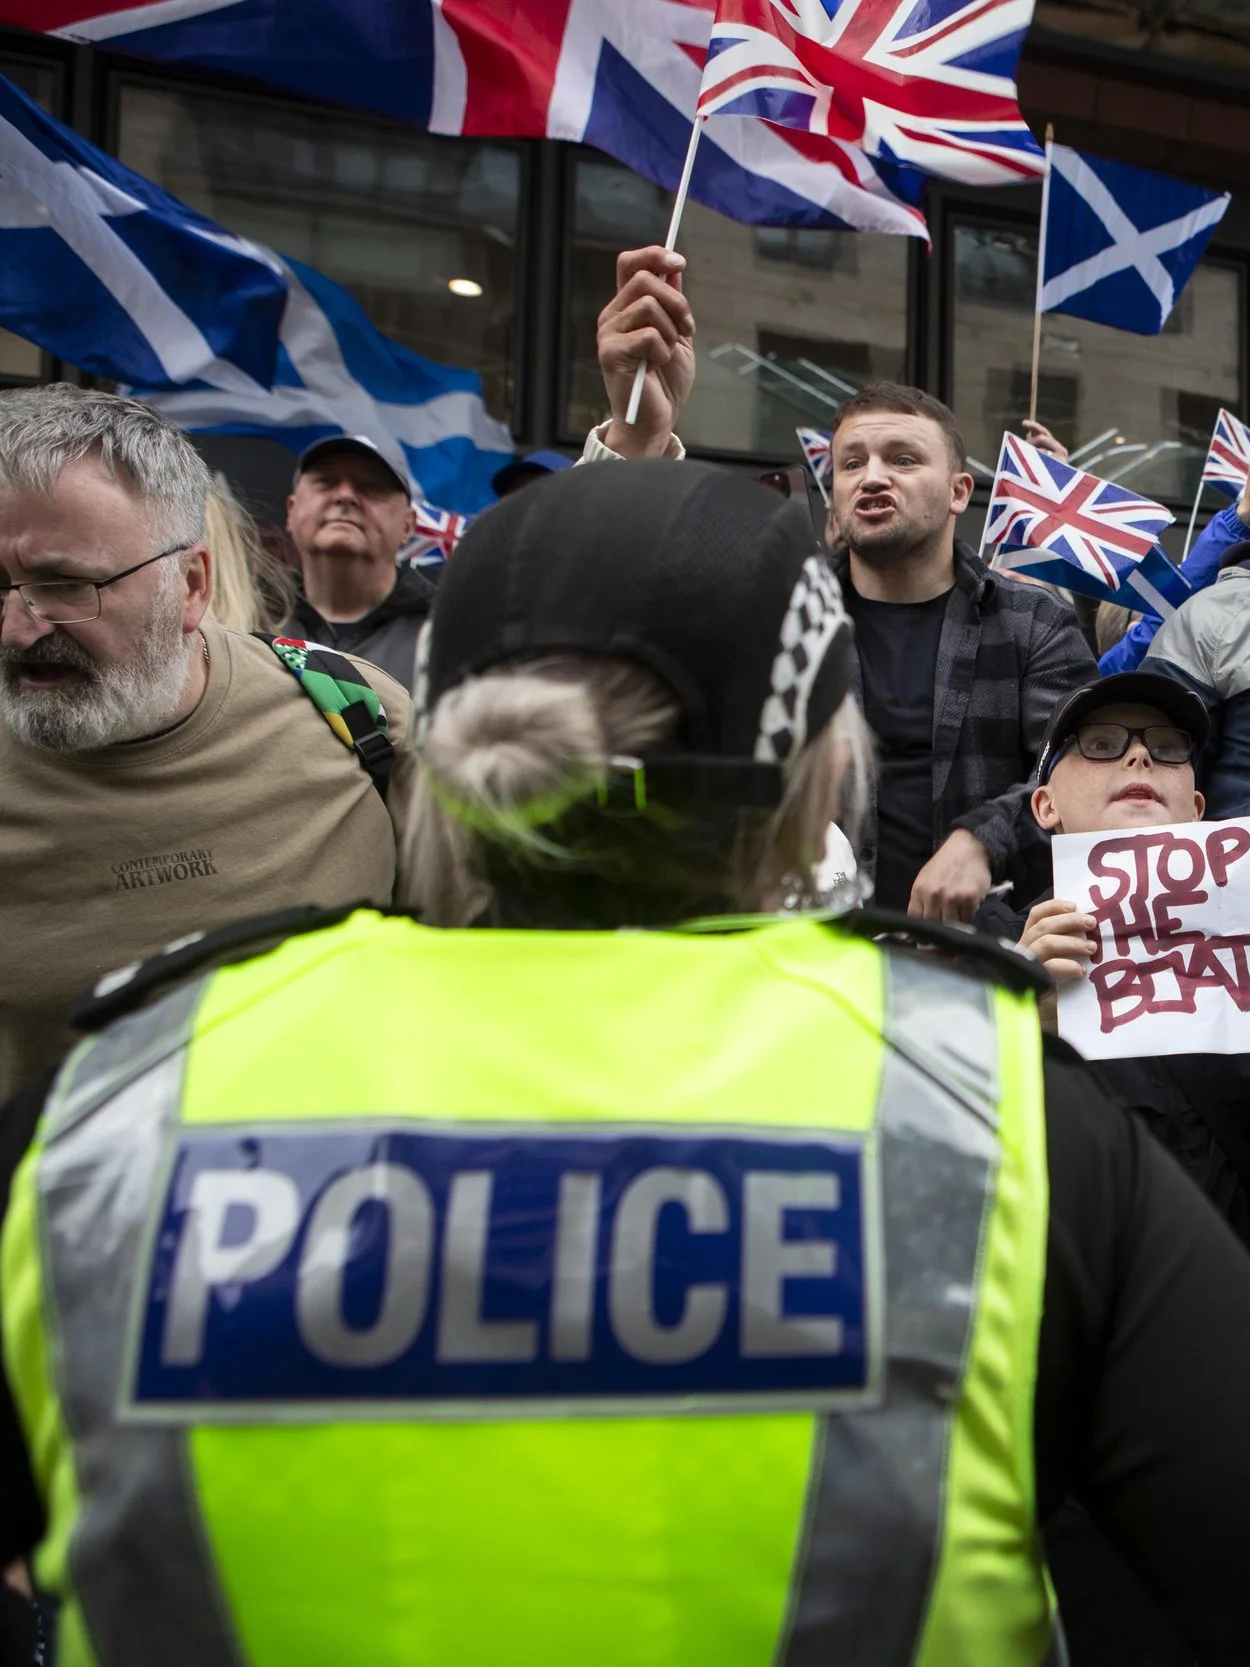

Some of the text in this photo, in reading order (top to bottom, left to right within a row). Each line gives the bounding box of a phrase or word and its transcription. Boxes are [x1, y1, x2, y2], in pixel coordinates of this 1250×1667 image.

[111, 849, 212, 874] CONTEMPORARY
[117, 860, 218, 890] ARTWORK
[1085, 889, 1208, 964] THE
[160, 1164, 843, 1368] POLICE
